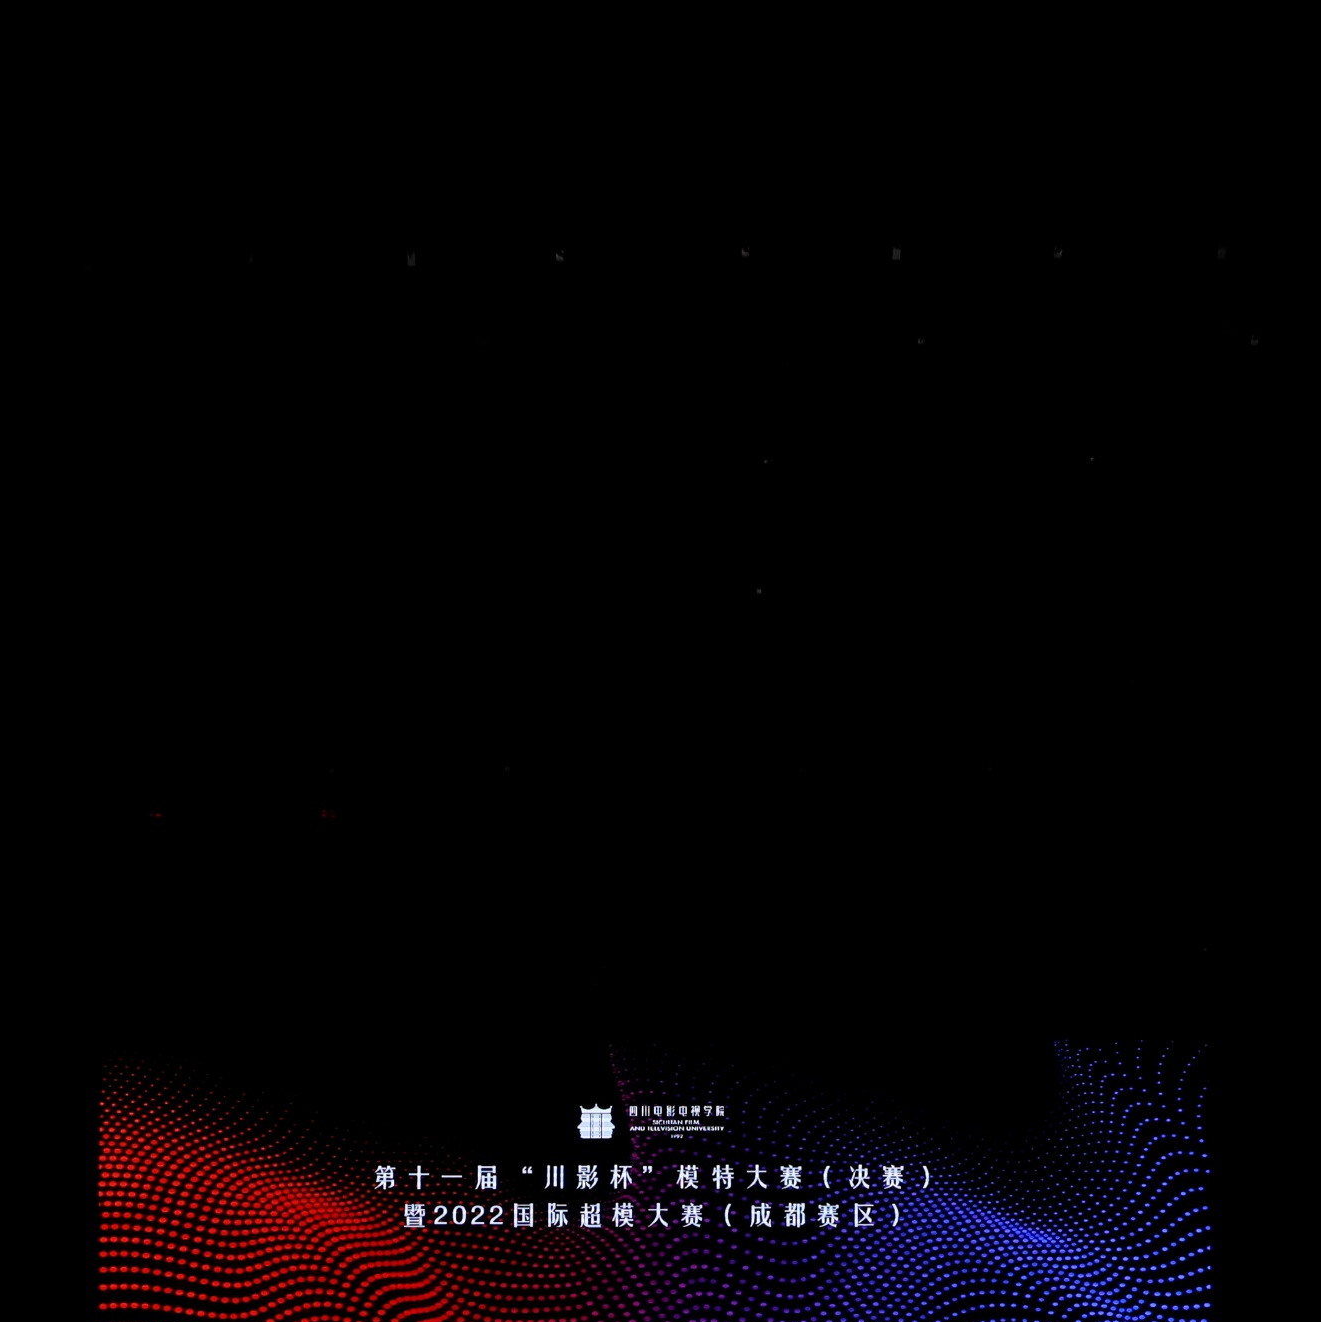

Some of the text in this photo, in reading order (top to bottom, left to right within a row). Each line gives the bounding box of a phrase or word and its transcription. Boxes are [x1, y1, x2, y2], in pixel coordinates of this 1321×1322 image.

[629, 1105, 725, 1117] 四川电影电视学院
